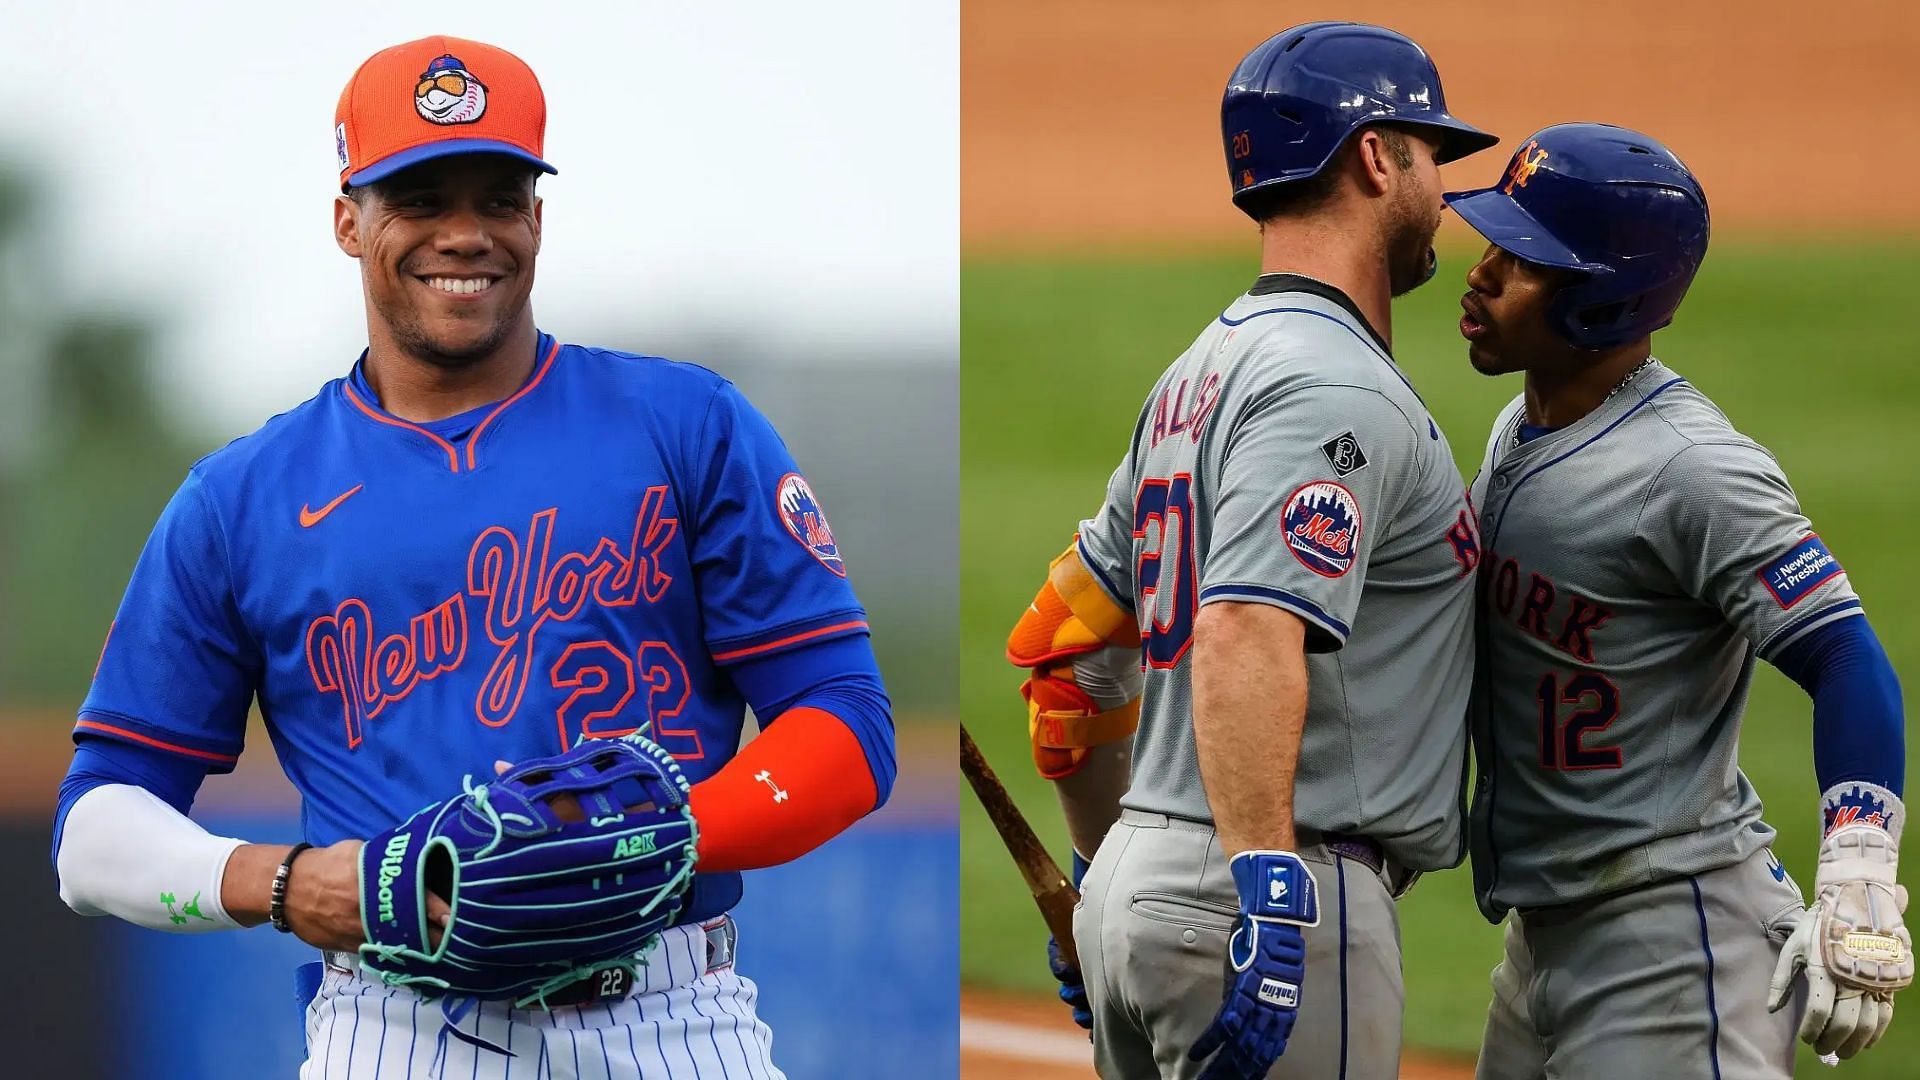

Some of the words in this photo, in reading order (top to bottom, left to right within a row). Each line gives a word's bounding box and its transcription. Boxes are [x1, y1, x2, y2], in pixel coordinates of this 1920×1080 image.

[1231, 132, 1250, 159] 20
[1295, 513, 1351, 556] Mets
[306, 593, 468, 750] New
[468, 485, 678, 728] York
[550, 640, 704, 759] 22
[1537, 671, 1623, 771] 12
[612, 831, 657, 859] A2K
[379, 832, 412, 923] Wilson
[600, 967, 623, 996] 22
[1261, 983, 1297, 1005] Franklin
